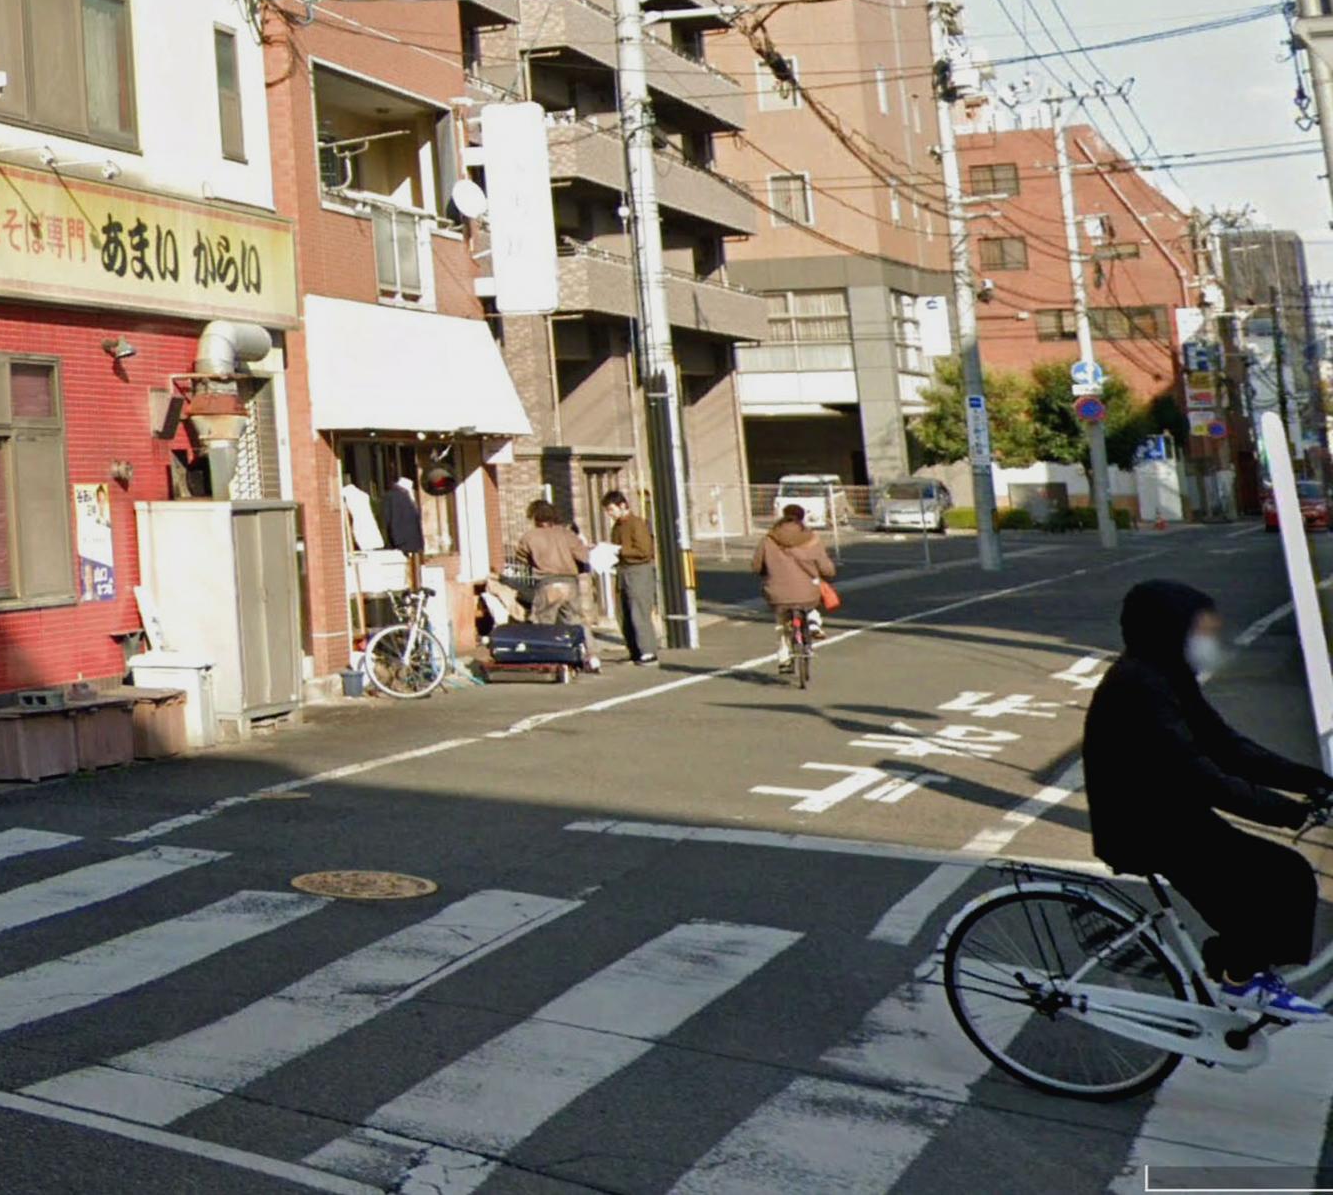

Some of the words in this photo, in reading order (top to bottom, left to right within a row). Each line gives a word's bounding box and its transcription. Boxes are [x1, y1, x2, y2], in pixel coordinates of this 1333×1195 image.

[100, 211, 180, 284] あまい
[192, 229, 262, 296] からい
